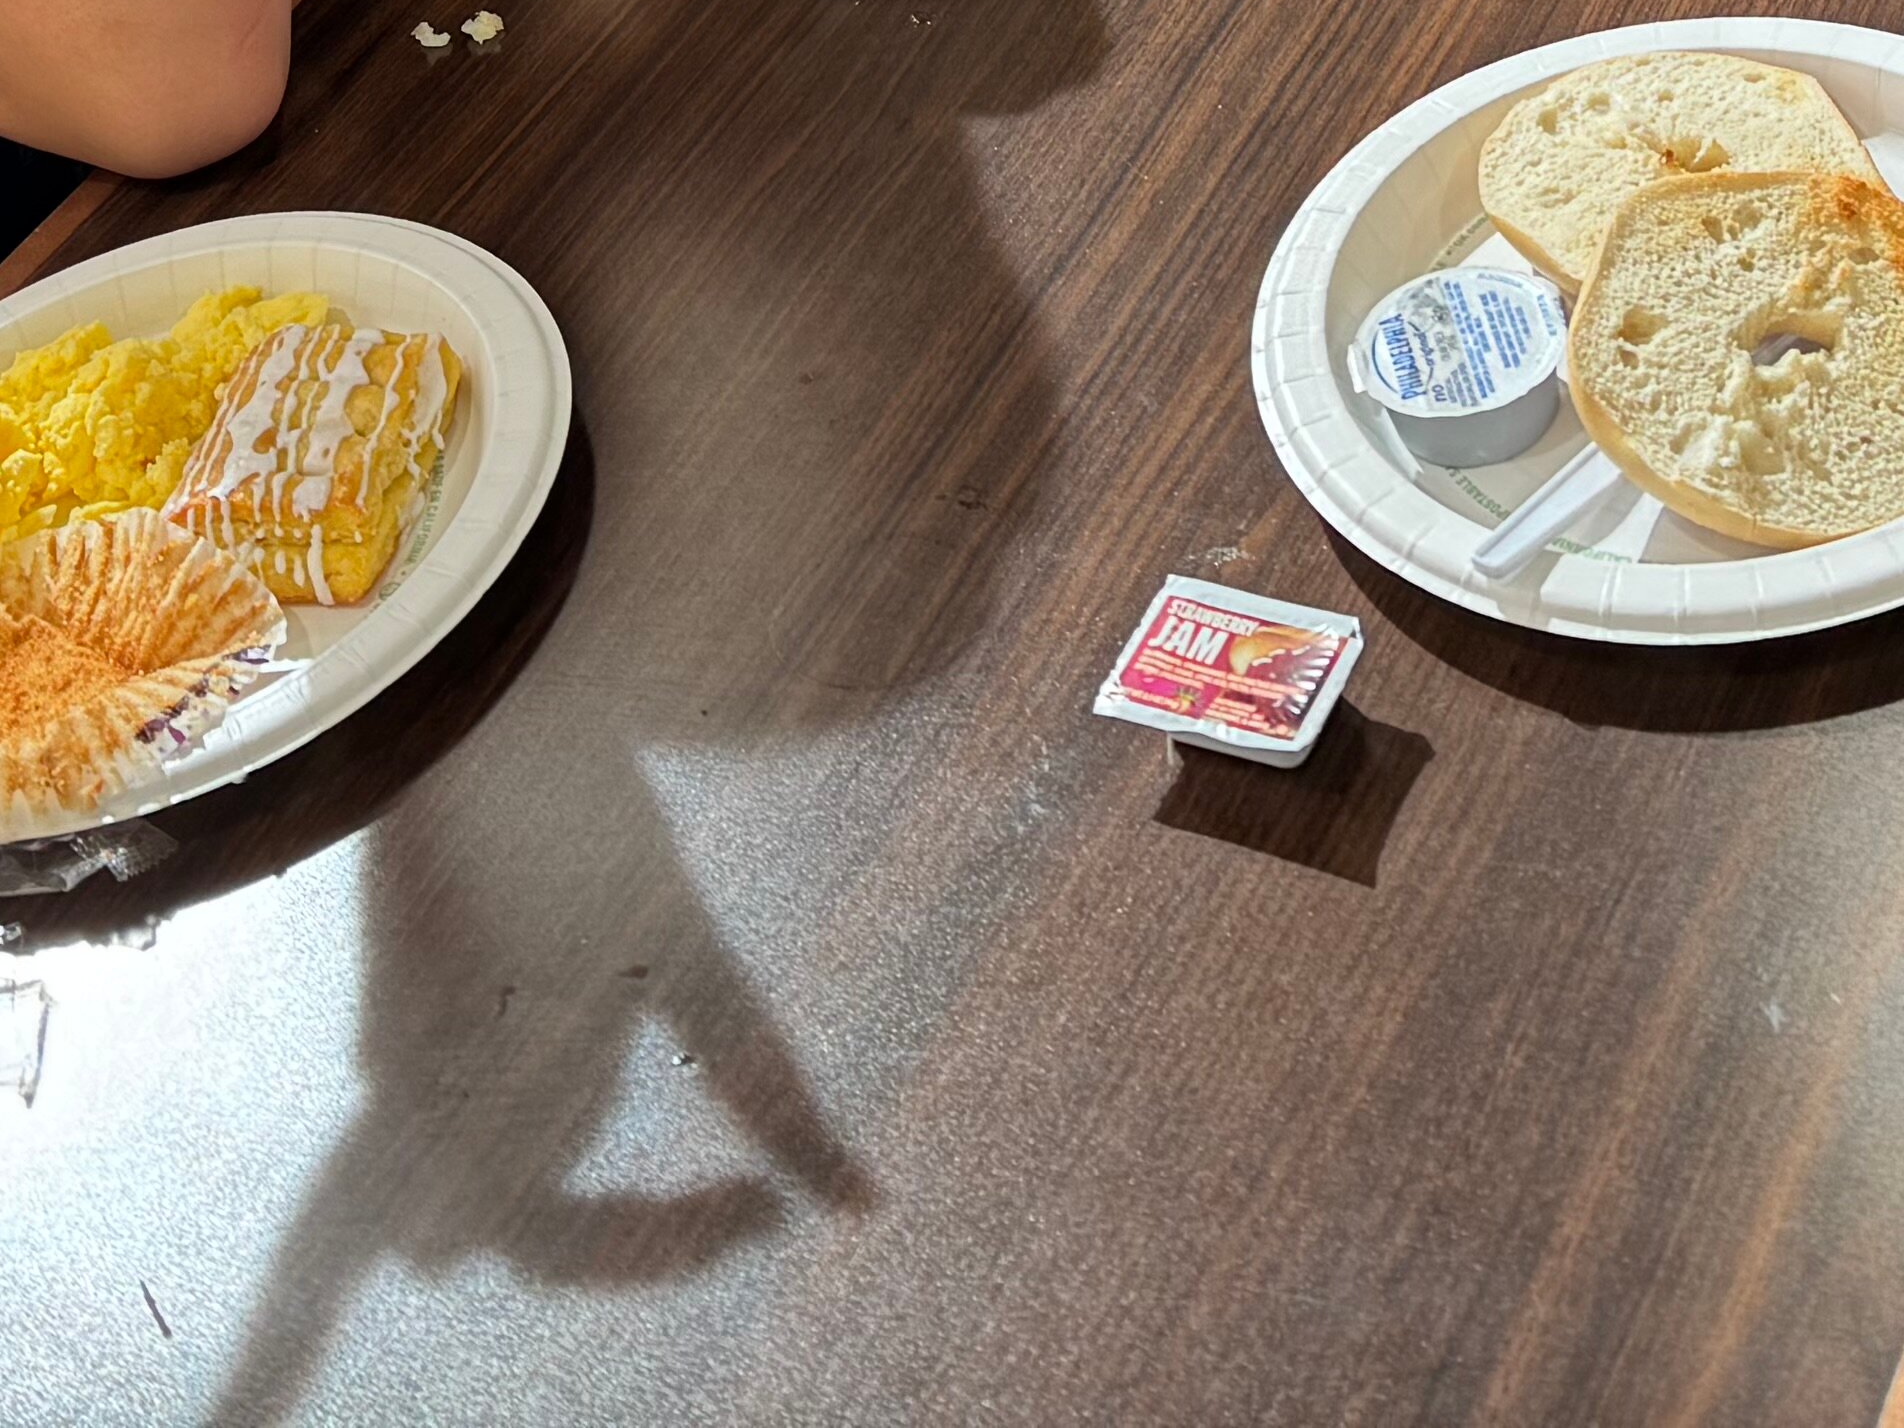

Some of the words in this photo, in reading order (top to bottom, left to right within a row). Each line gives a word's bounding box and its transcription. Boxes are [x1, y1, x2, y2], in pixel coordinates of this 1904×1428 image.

[1378, 313, 1428, 400] PHILADELPHIA
[1431, 384, 1448, 402] no
[1167, 598, 1260, 637] STRAWBERRY
[1147, 616, 1229, 666] JAM
